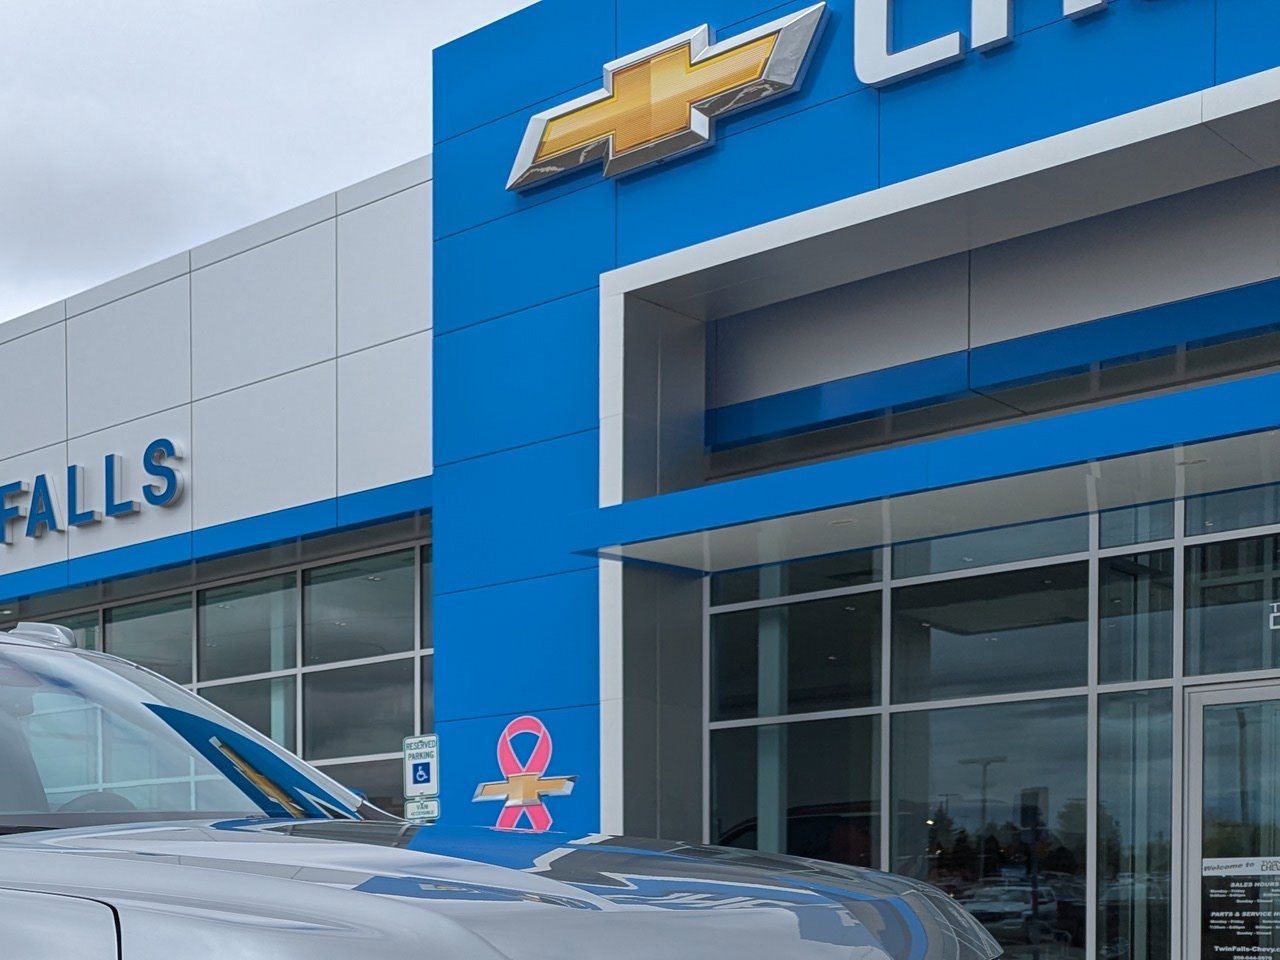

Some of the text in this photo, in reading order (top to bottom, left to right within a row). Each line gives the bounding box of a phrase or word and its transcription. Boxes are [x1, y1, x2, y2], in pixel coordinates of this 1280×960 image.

[406, 740, 436, 750] RESERVED
[408, 751, 435, 761] PARKING
[1204, 863, 1243, 871] Welcome
